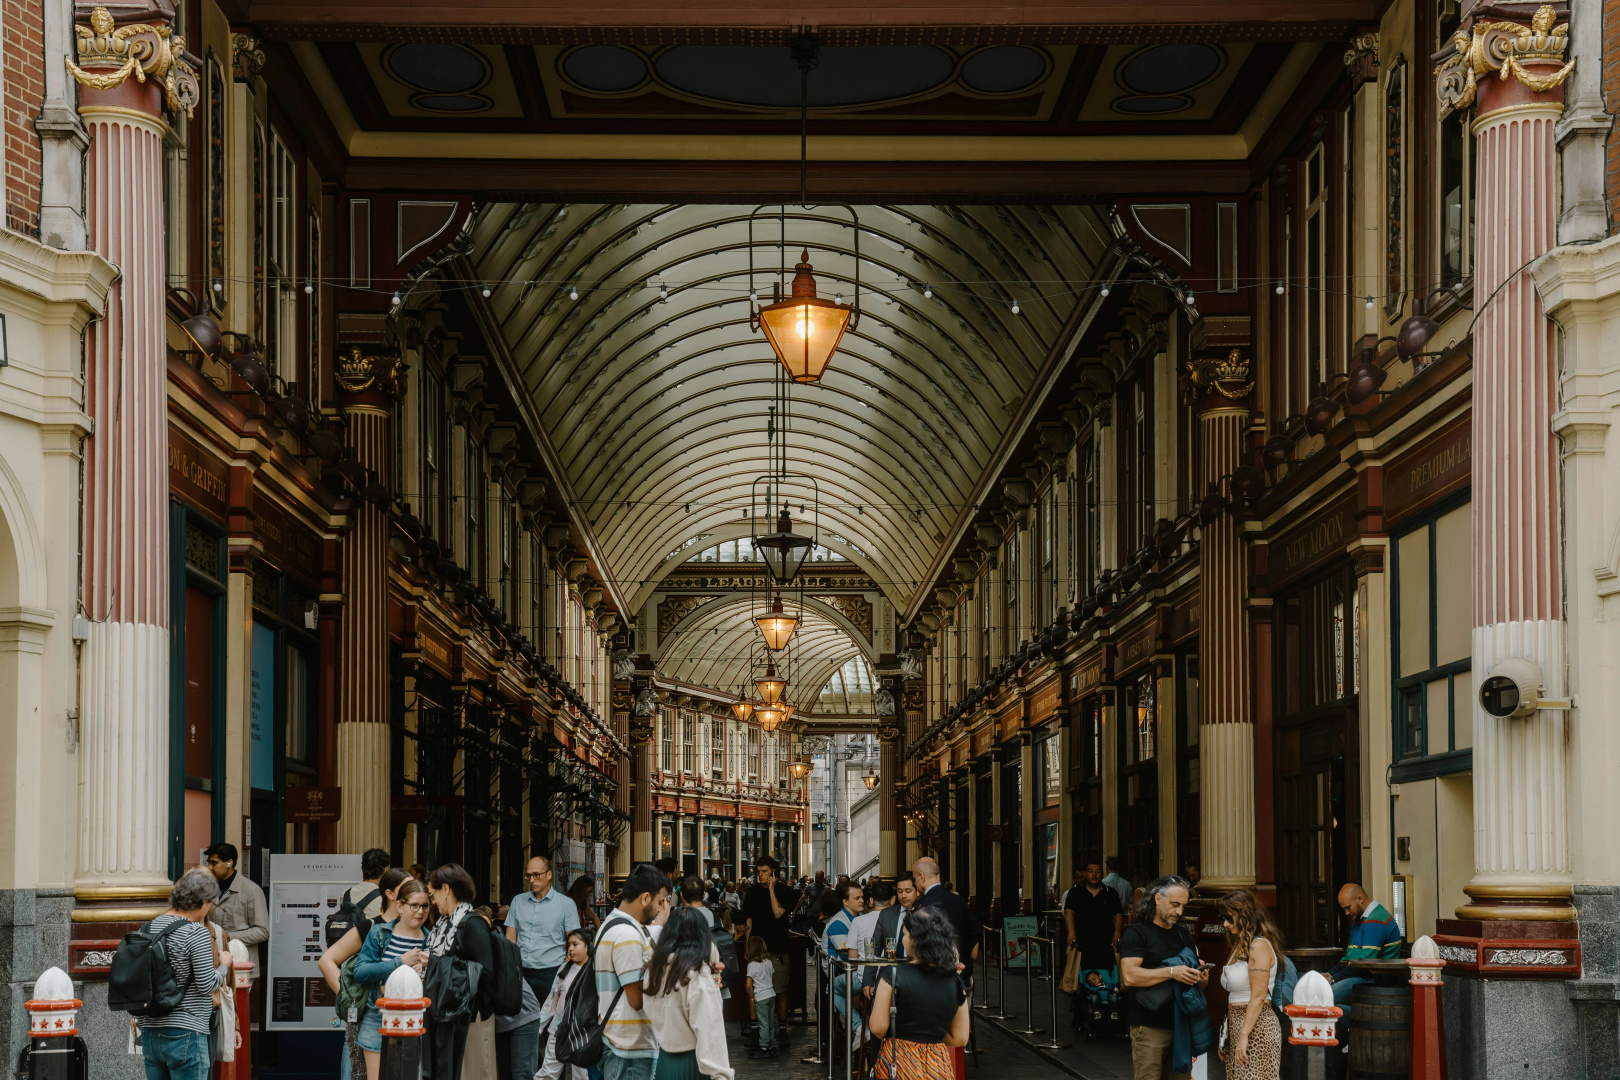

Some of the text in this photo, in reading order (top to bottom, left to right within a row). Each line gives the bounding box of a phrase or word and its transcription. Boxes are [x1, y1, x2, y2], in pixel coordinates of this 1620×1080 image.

[182, 454, 189, 479] &
[190, 461, 226, 503] GRIFFIN
[1410, 437, 1471, 492] PREMIUM LA
[1285, 511, 1343, 571] NEW MOON
